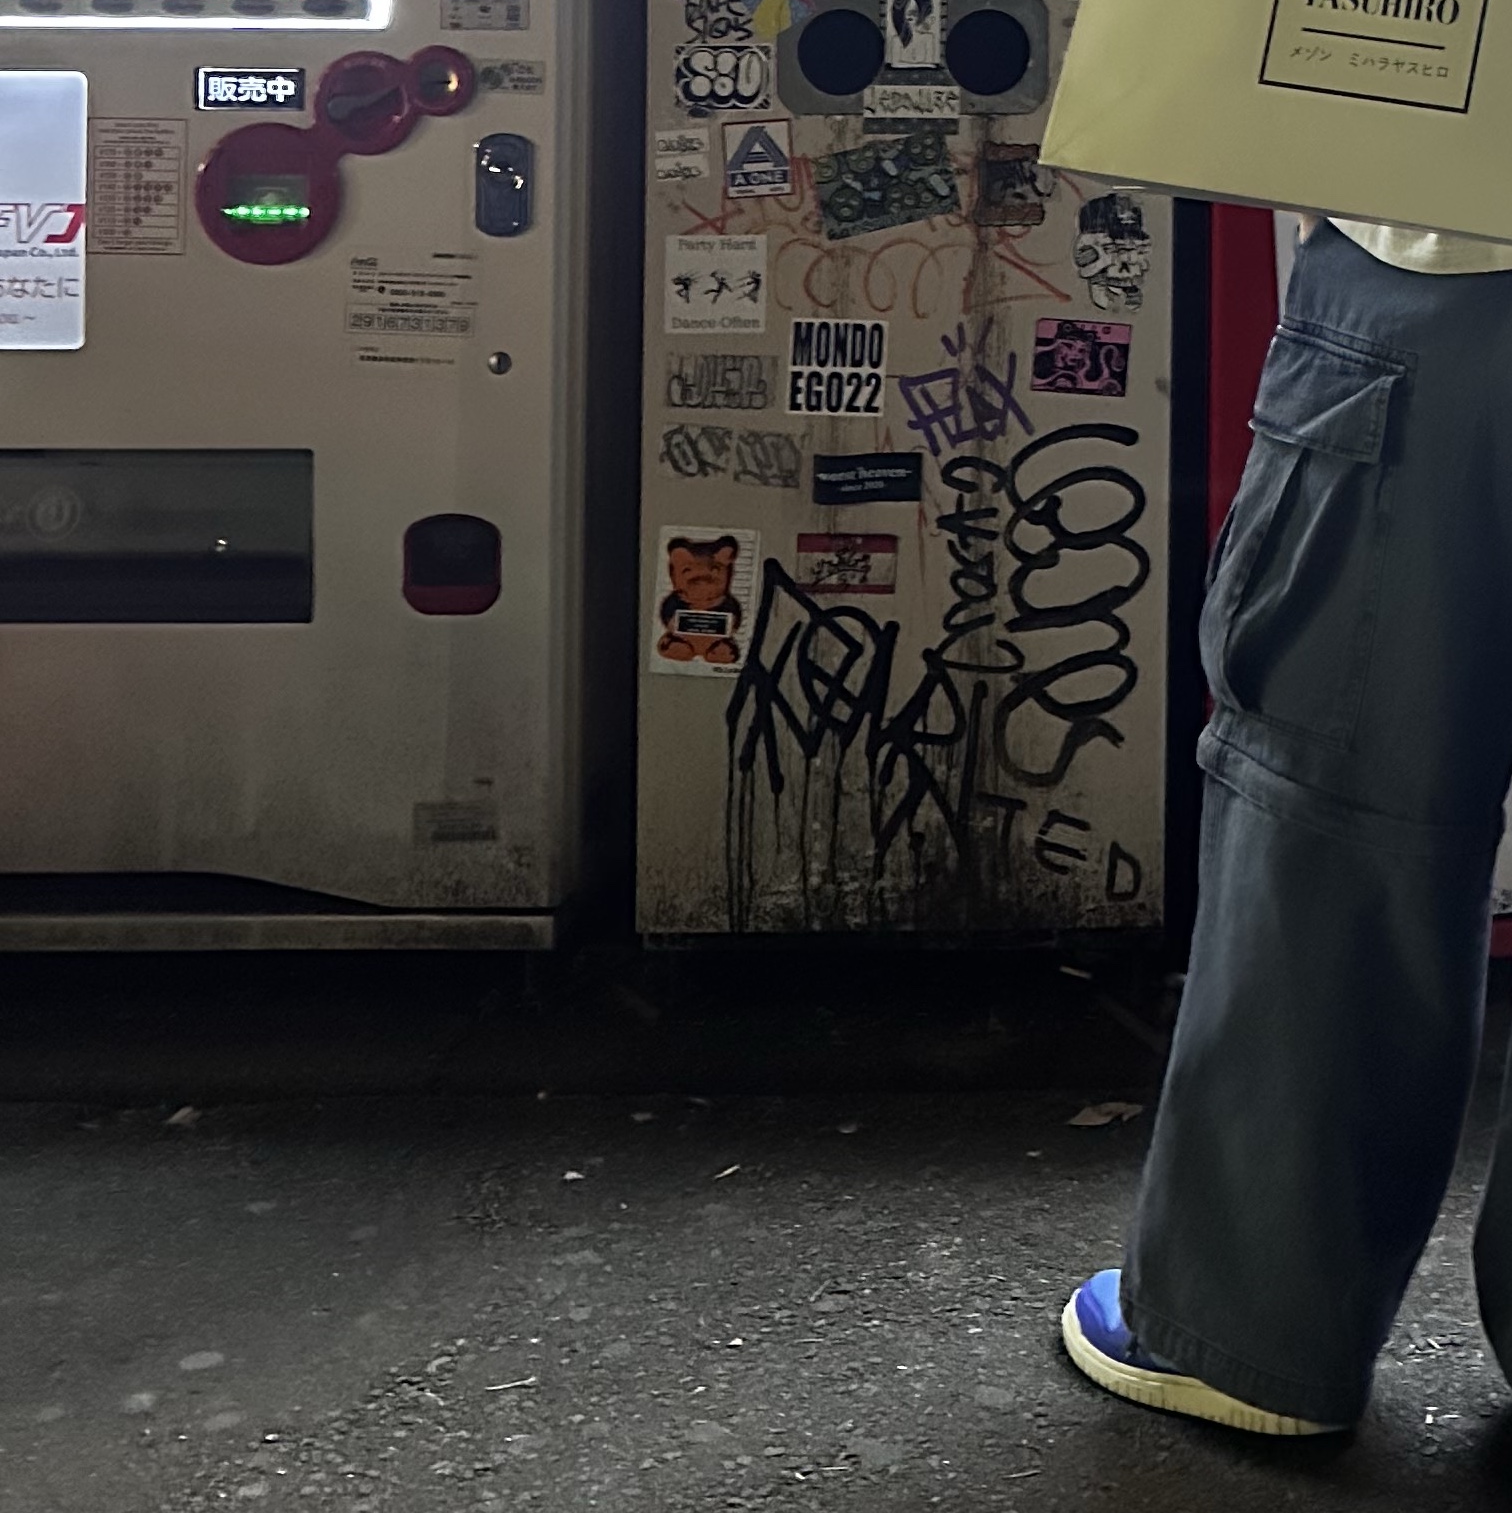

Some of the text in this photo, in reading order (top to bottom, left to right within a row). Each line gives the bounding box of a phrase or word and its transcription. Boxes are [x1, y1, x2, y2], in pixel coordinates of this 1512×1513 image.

[1289, 45, 1450, 78] メゾン ミハラヤスヒロ
[207, 76, 297, 104] 販売中
[734, 170, 786, 185] A ONE
[678, 239, 715, 253] Party
[671, 317, 721, 330] Dance
[792, 321, 884, 369] MONDO
[789, 371, 883, 412] EGO22
